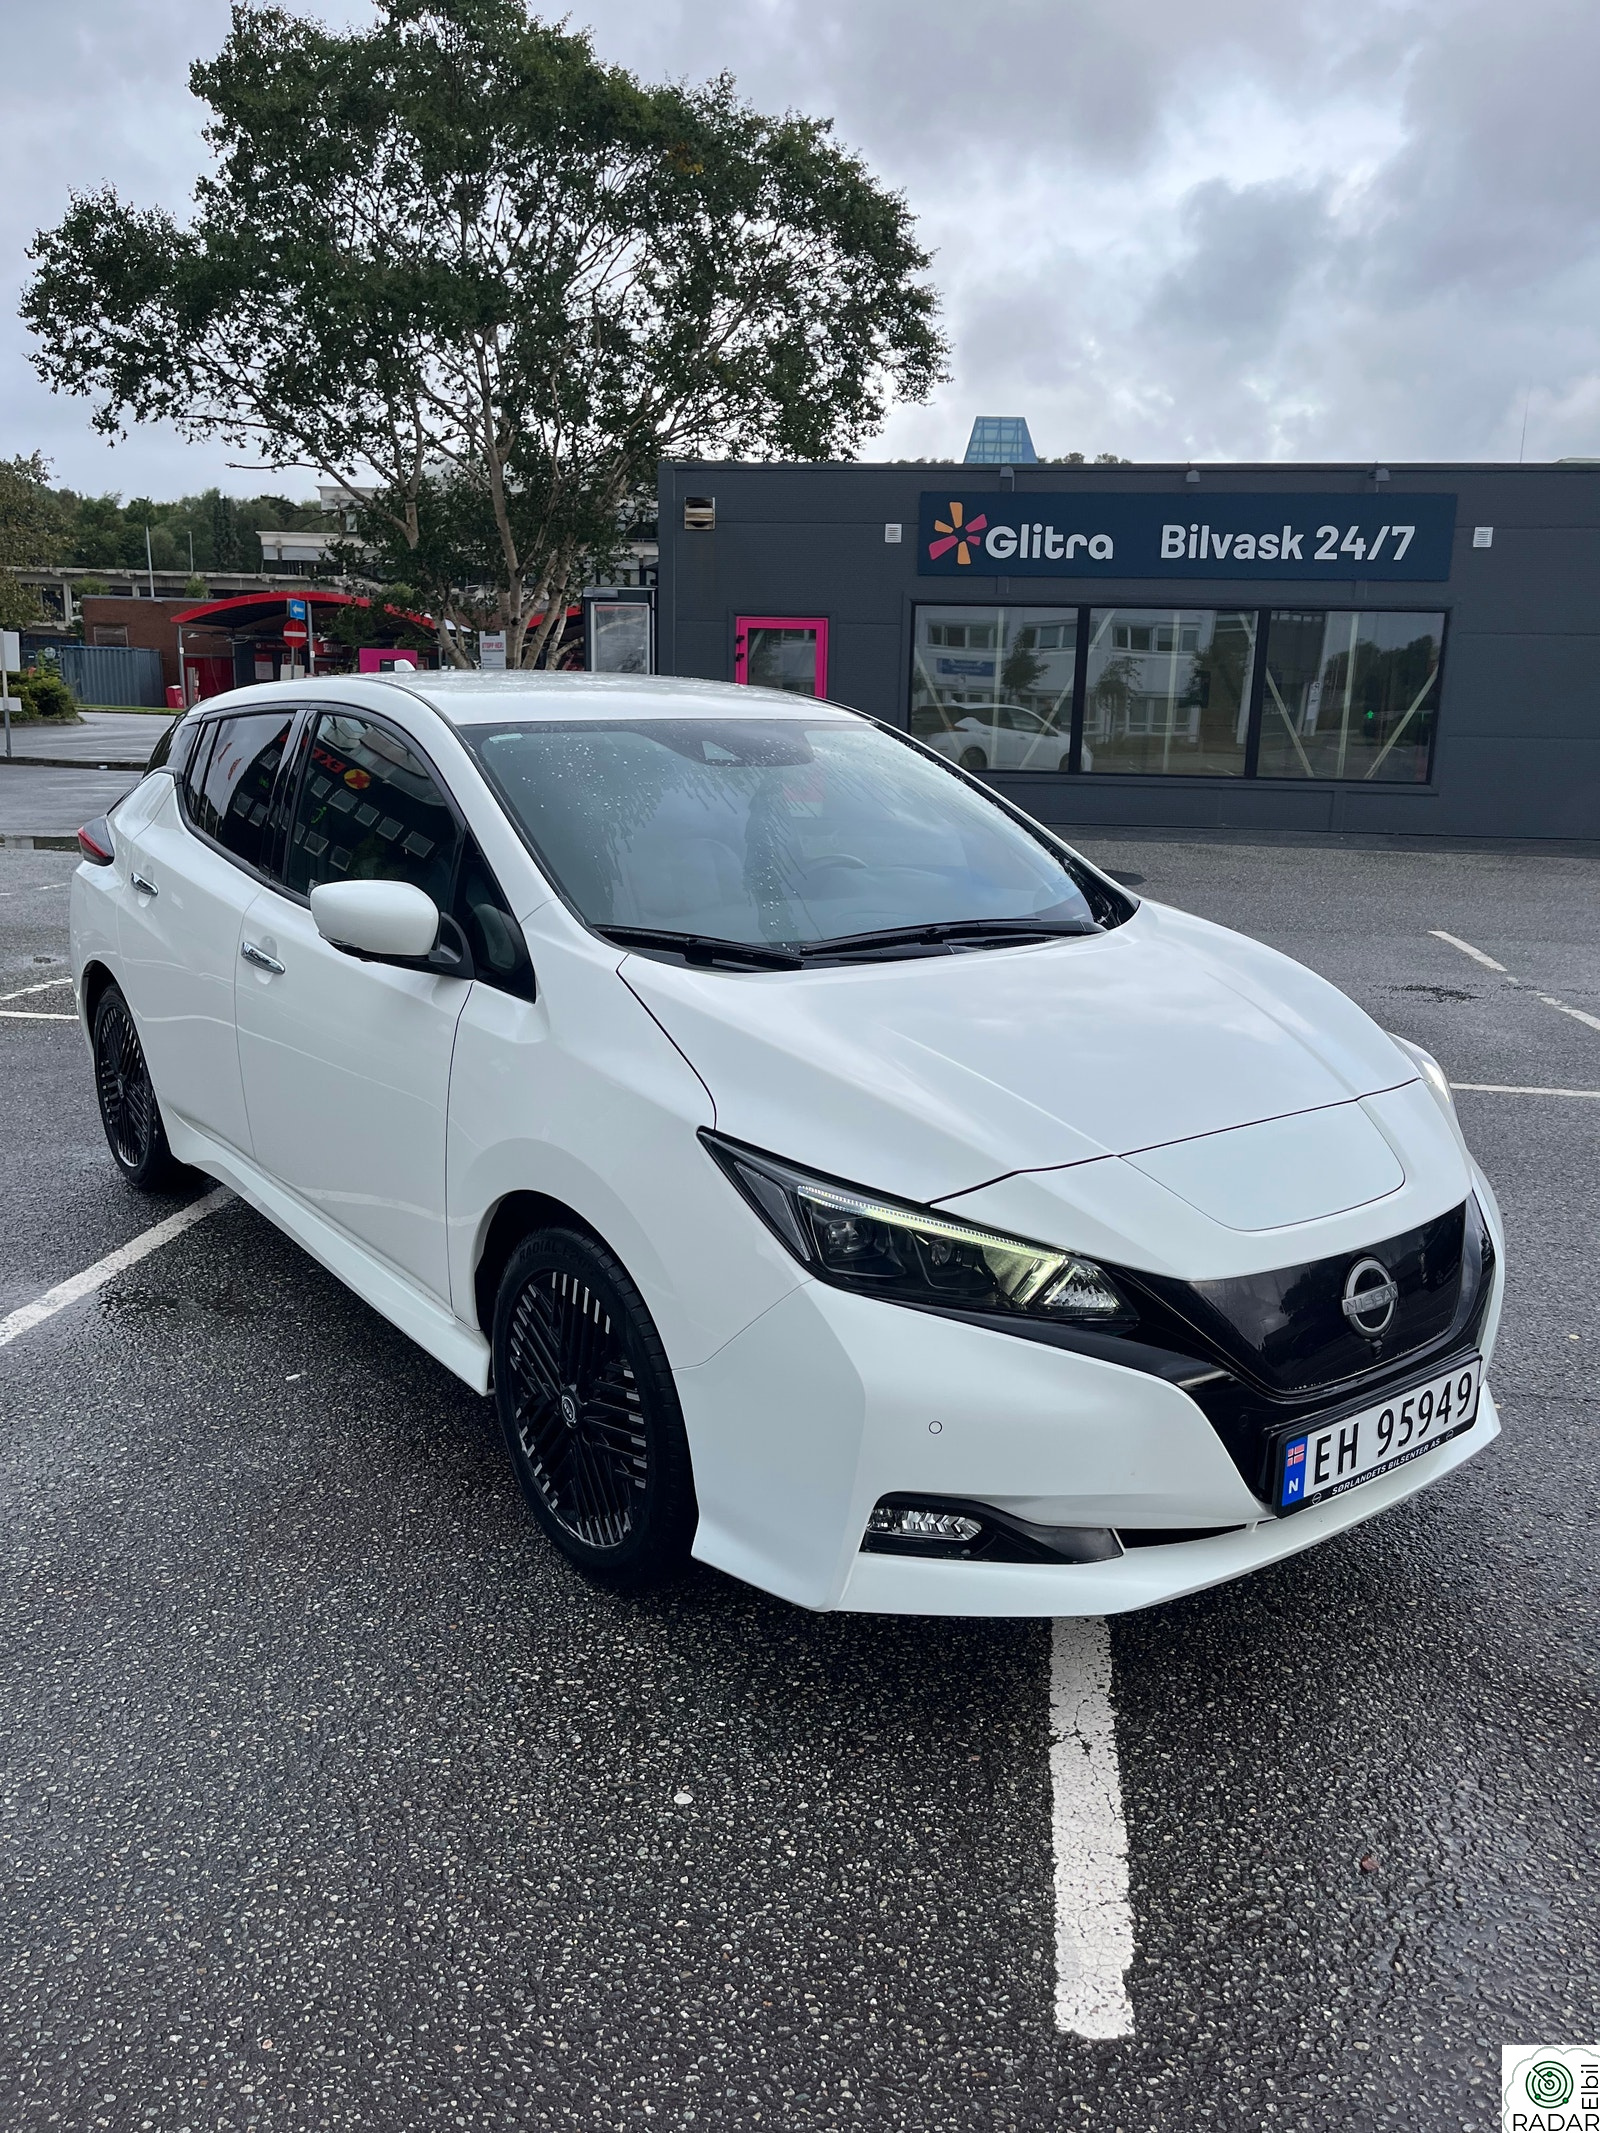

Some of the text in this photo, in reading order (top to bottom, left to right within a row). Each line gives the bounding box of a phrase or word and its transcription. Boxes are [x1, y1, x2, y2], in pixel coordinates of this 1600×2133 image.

[985, 523, 1416, 561] Glitra Bilvask 24/7
[1345, 1286, 1398, 1313] NISSAN
[1314, 1371, 1472, 1485] EH 95949
[1332, 1438, 1440, 1495] SØRLANDETS BILSENTER AS
[1288, 1478, 1299, 1494] N
